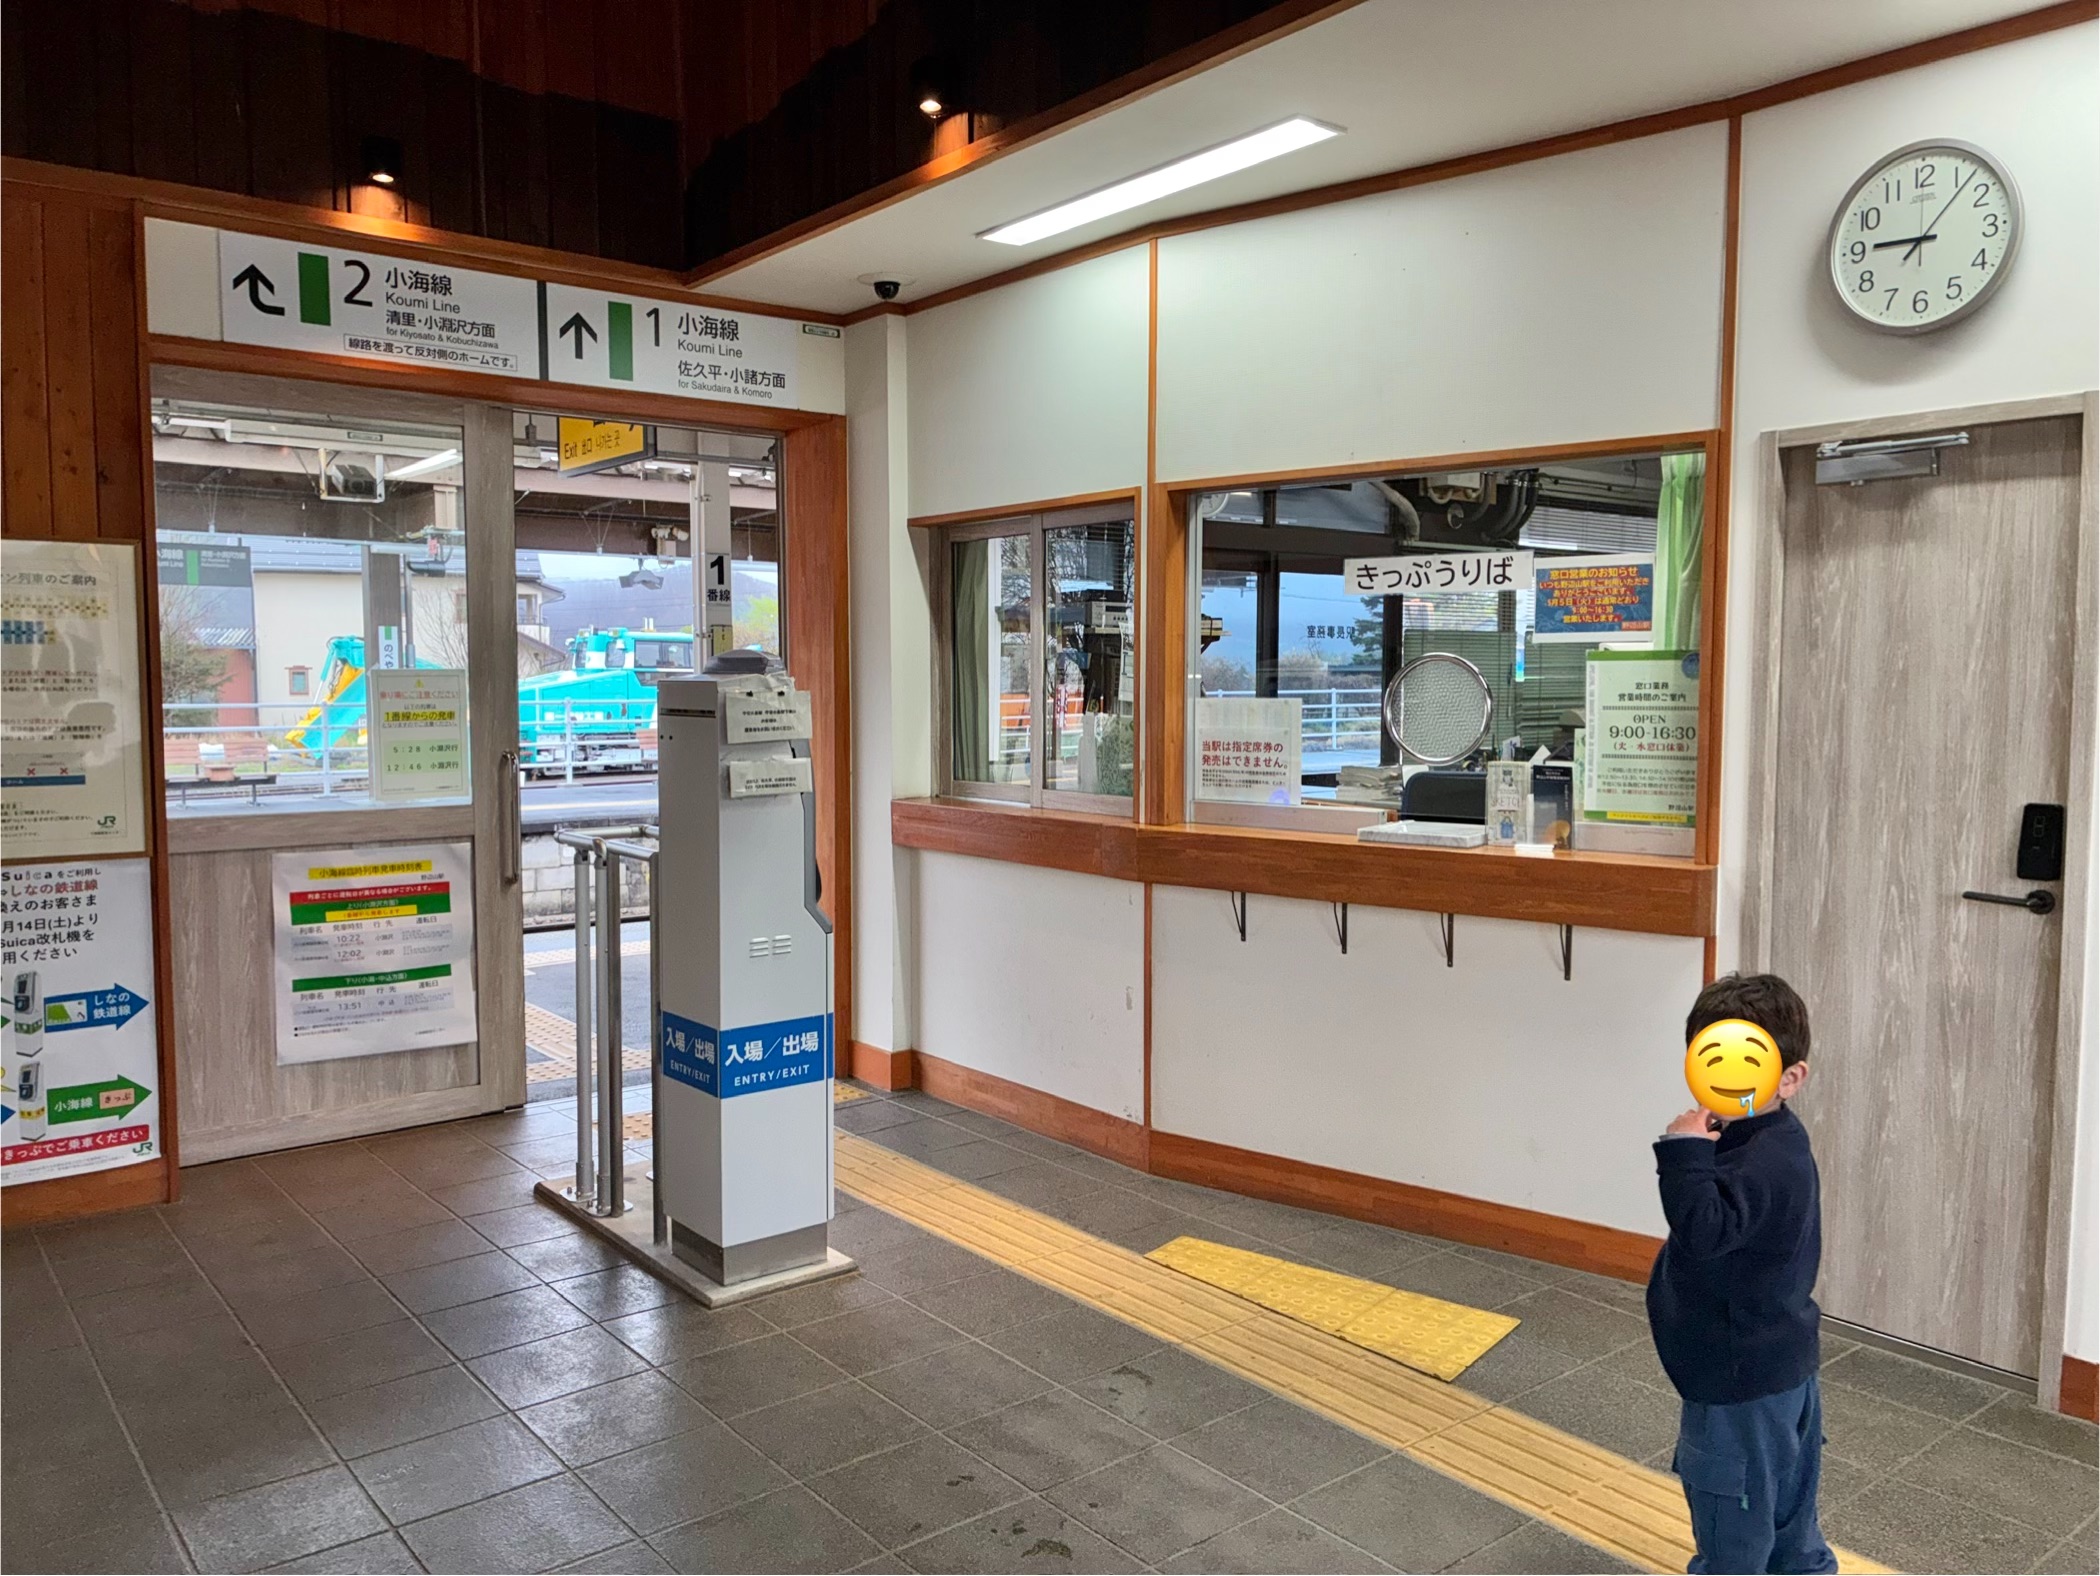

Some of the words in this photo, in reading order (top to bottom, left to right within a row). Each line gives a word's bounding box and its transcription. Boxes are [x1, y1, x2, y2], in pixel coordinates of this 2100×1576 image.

[1915, 164, 1935, 189] 12
[1955, 167, 1958, 188] 1
[1886, 179, 1900, 203] 11
[1973, 183, 1989, 208] 2
[1861, 207, 1880, 232] 10
[1982, 213, 1998, 238] 3
[1851, 241, 1866, 264] 9
[1970, 248, 1988, 270] 4
[344, 259, 373, 307] 2
[385, 267, 453, 296] 小海線
[1859, 270, 1874, 292] 8
[1946, 276, 1962, 300] 5
[386, 292, 428, 309] Koumi
[433, 299, 461, 314] Line
[1884, 288, 1899, 311] 7
[1912, 290, 1928, 313] 6
[386, 309, 495, 338] 清里・小淵沢方面
[646, 307, 660, 347] 1
[678, 312, 740, 342] 小海線
[386, 327, 398, 335] for
[400, 329, 436, 342] Kiyosato
[438, 334, 444, 342] &
[446, 336, 499, 349] Kobuchizawa
[678, 339, 715, 355] Koumi
[718, 345, 743, 358] Line
[348, 337, 514, 368] 線路を渡って反対側のホームです。
[678, 360, 786, 389] 佐久平・小諸方面
[678, 380, 689, 388] for
[691, 381, 732, 394] Sakudaira
[741, 387, 773, 399] Komoro
[564, 442, 577, 460] Exit
[710, 556, 724, 585] 1
[1356, 556, 1513, 590] きっぷうりば
[1550, 567, 1638, 579] 窓口営業のお知らせ
[707, 589, 731, 602] 番線
[1618, 693, 1686, 702] 営業時間のご案内
[1633, 714, 1666, 724] OPEN
[1202, 741, 1283, 753] 当駅は指定席券の
[1202, 755, 1287, 769] 発売はできません。
[98, 816, 116, 826] JR
[12, 879, 98, 898] しなの鉄道線
[337, 934, 360, 943] 10:22
[3, 947, 77, 965] 用ください
[337, 950, 361, 958] 12:02
[95, 991, 130, 1006] しなの
[338, 1002, 362, 1011] 13:51
[93, 1005, 131, 1019] 鉄道線
[670, 1060, 710, 1083] ENTRY/EXIT
[734, 1064, 810, 1086] ENTRY/EXIT
[54, 1097, 93, 1112] 小海線
[133, 1142, 153, 1153] JR
